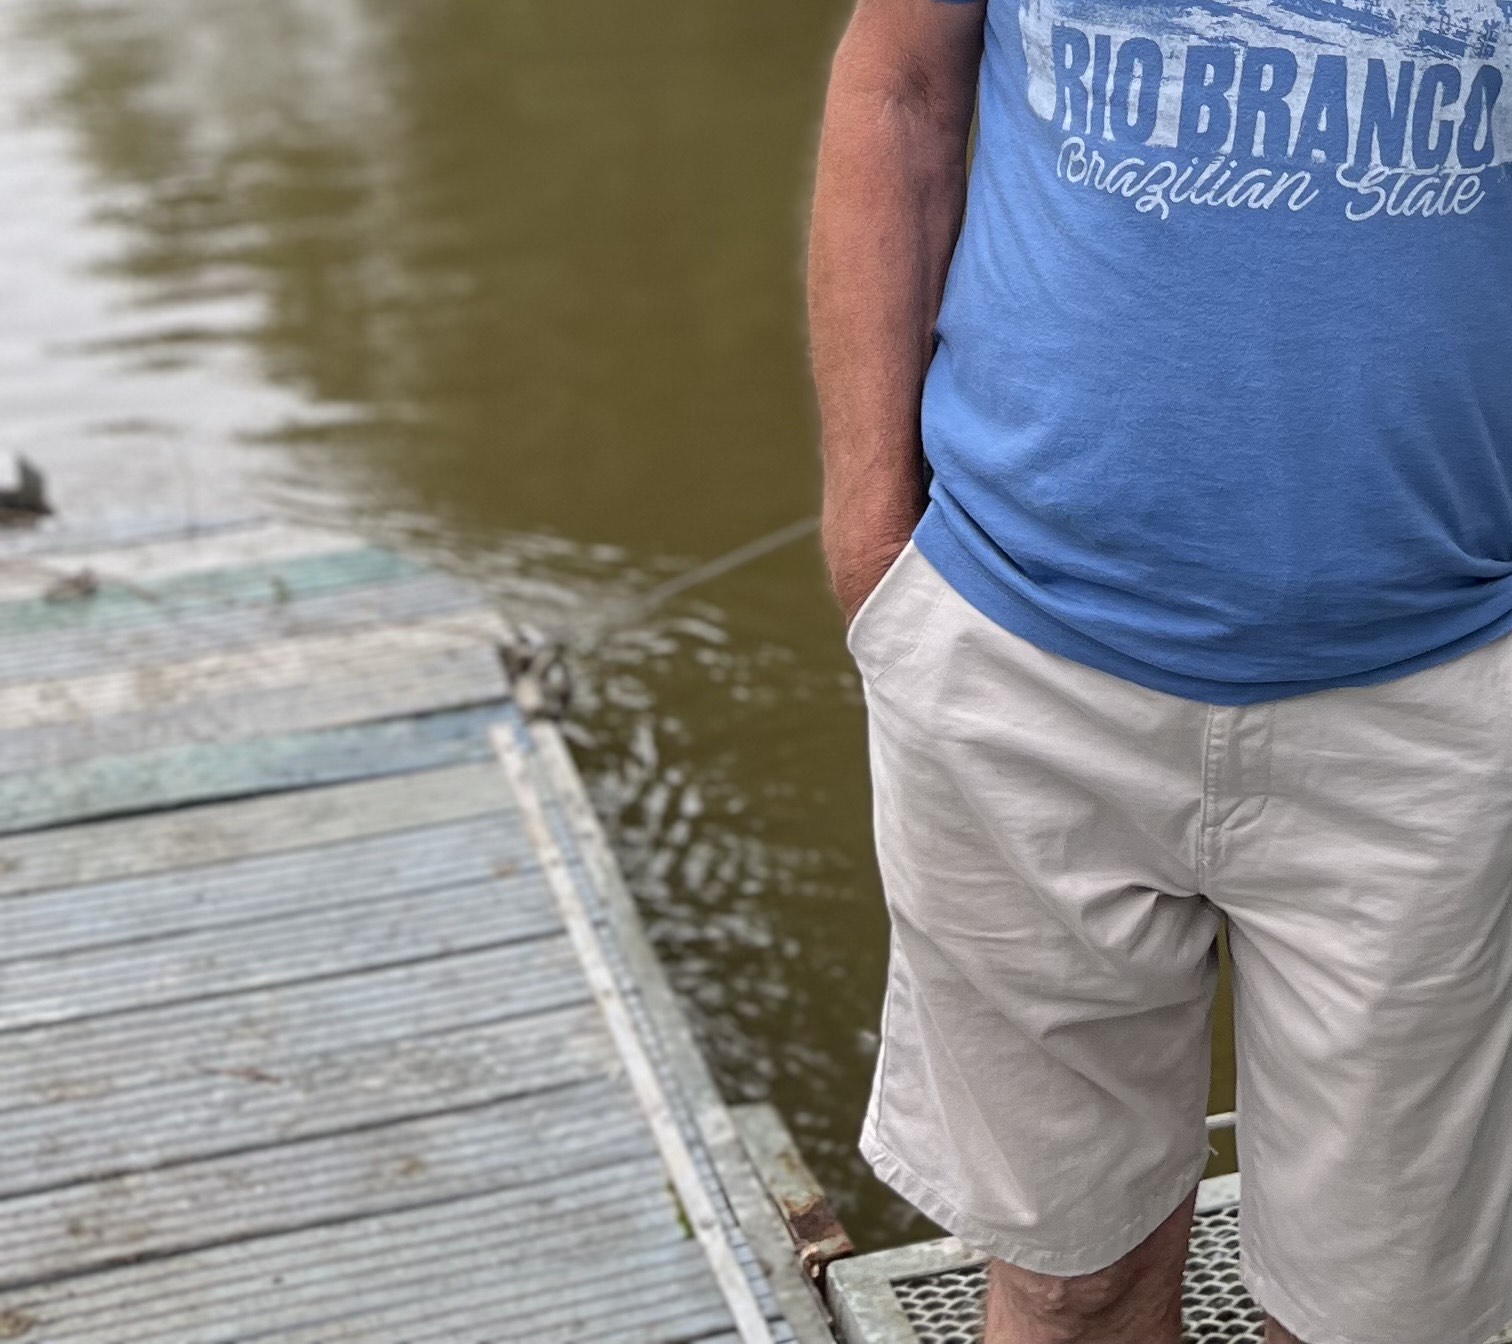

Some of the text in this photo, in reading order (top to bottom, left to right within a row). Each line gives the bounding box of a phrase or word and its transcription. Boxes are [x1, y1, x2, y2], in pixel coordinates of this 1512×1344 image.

[1052, 25, 1503, 171] RIO BRANCO
[1057, 137, 1486, 221] Brazilian State
